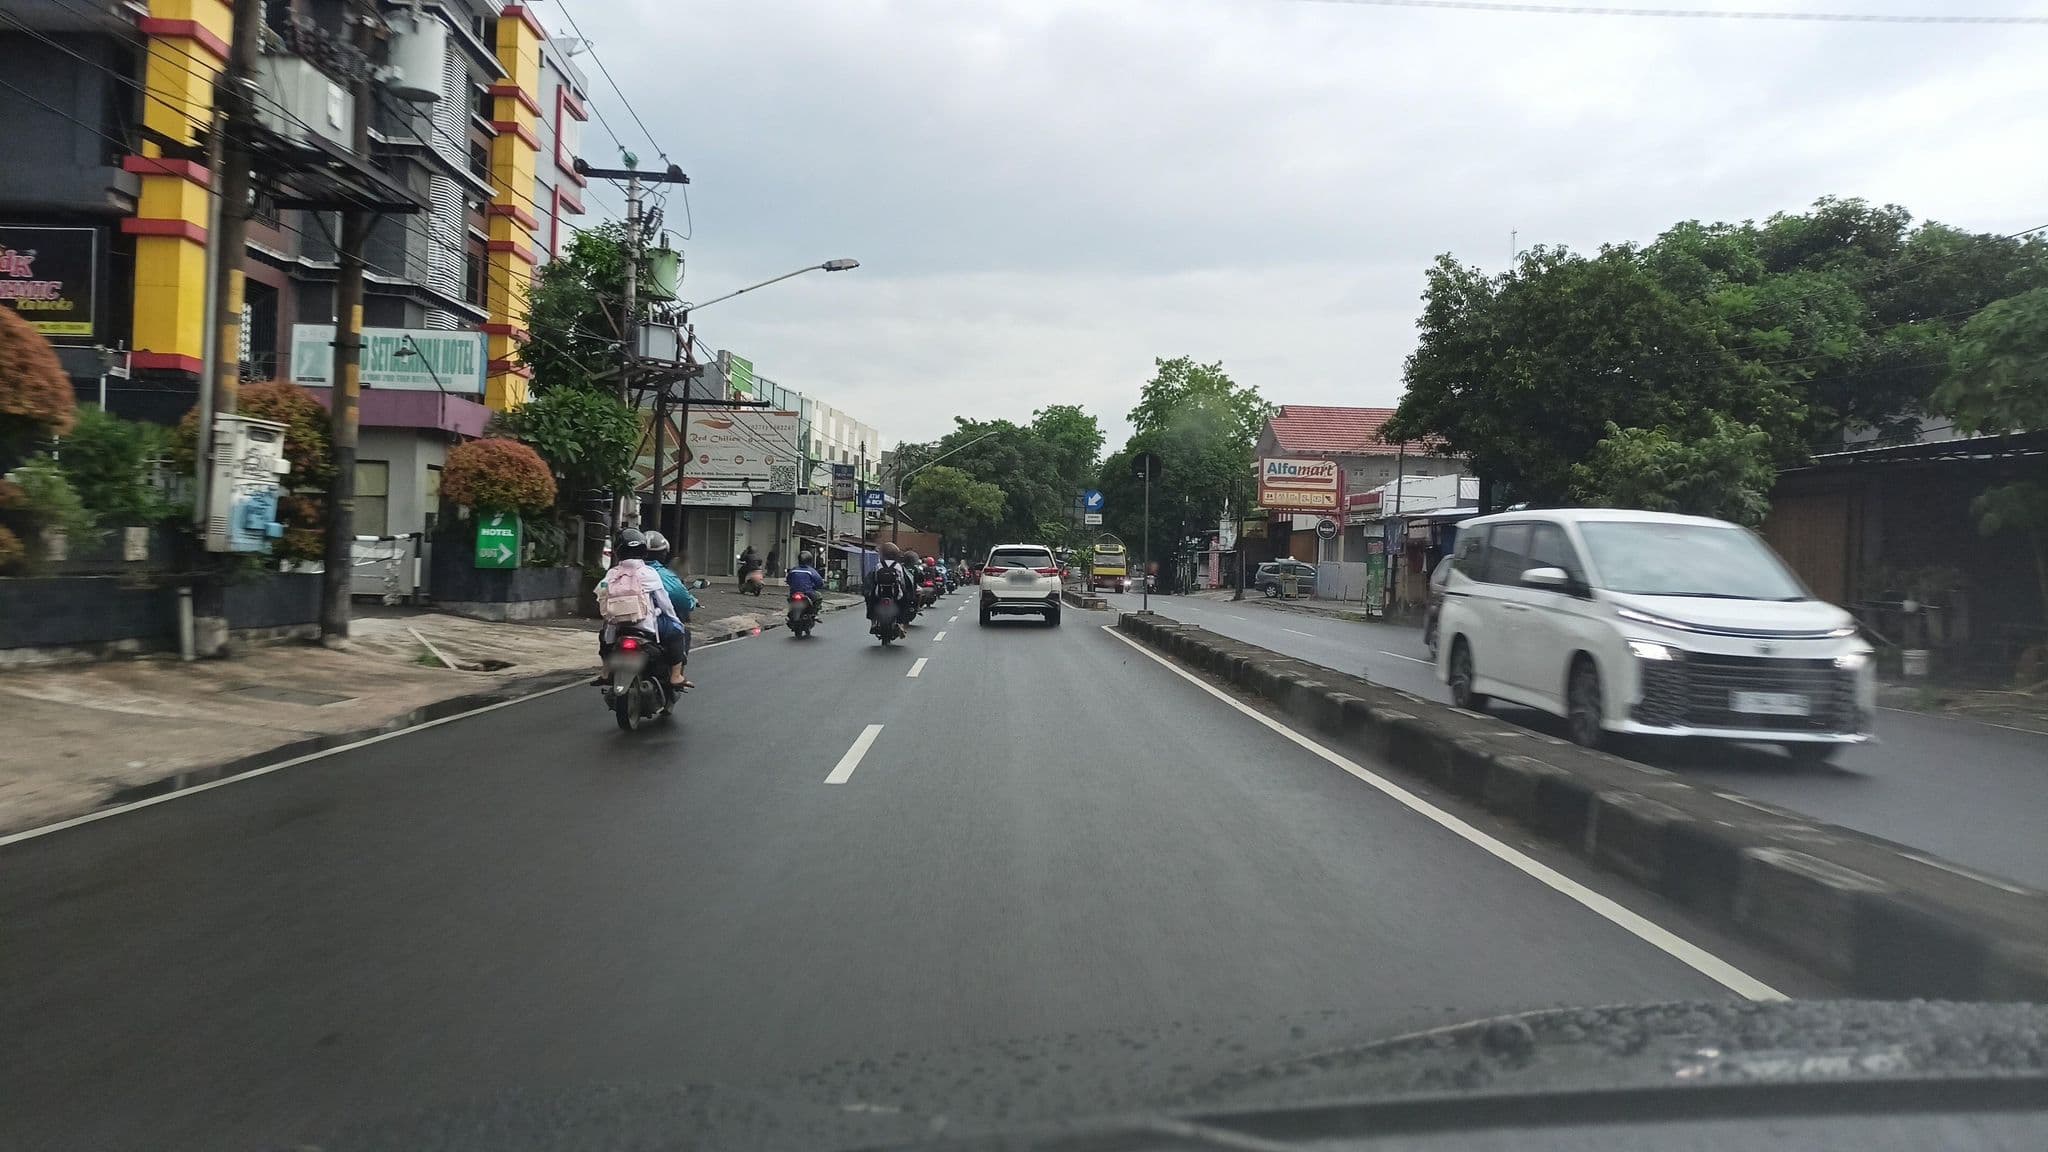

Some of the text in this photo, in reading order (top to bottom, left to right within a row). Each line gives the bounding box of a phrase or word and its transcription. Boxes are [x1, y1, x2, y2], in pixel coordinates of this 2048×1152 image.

[441, 339, 474, 375] HOTEL
[689, 433, 707, 443] Red
[1267, 462, 1333, 476] Alfamart
[480, 528, 515, 537] HOTEL
